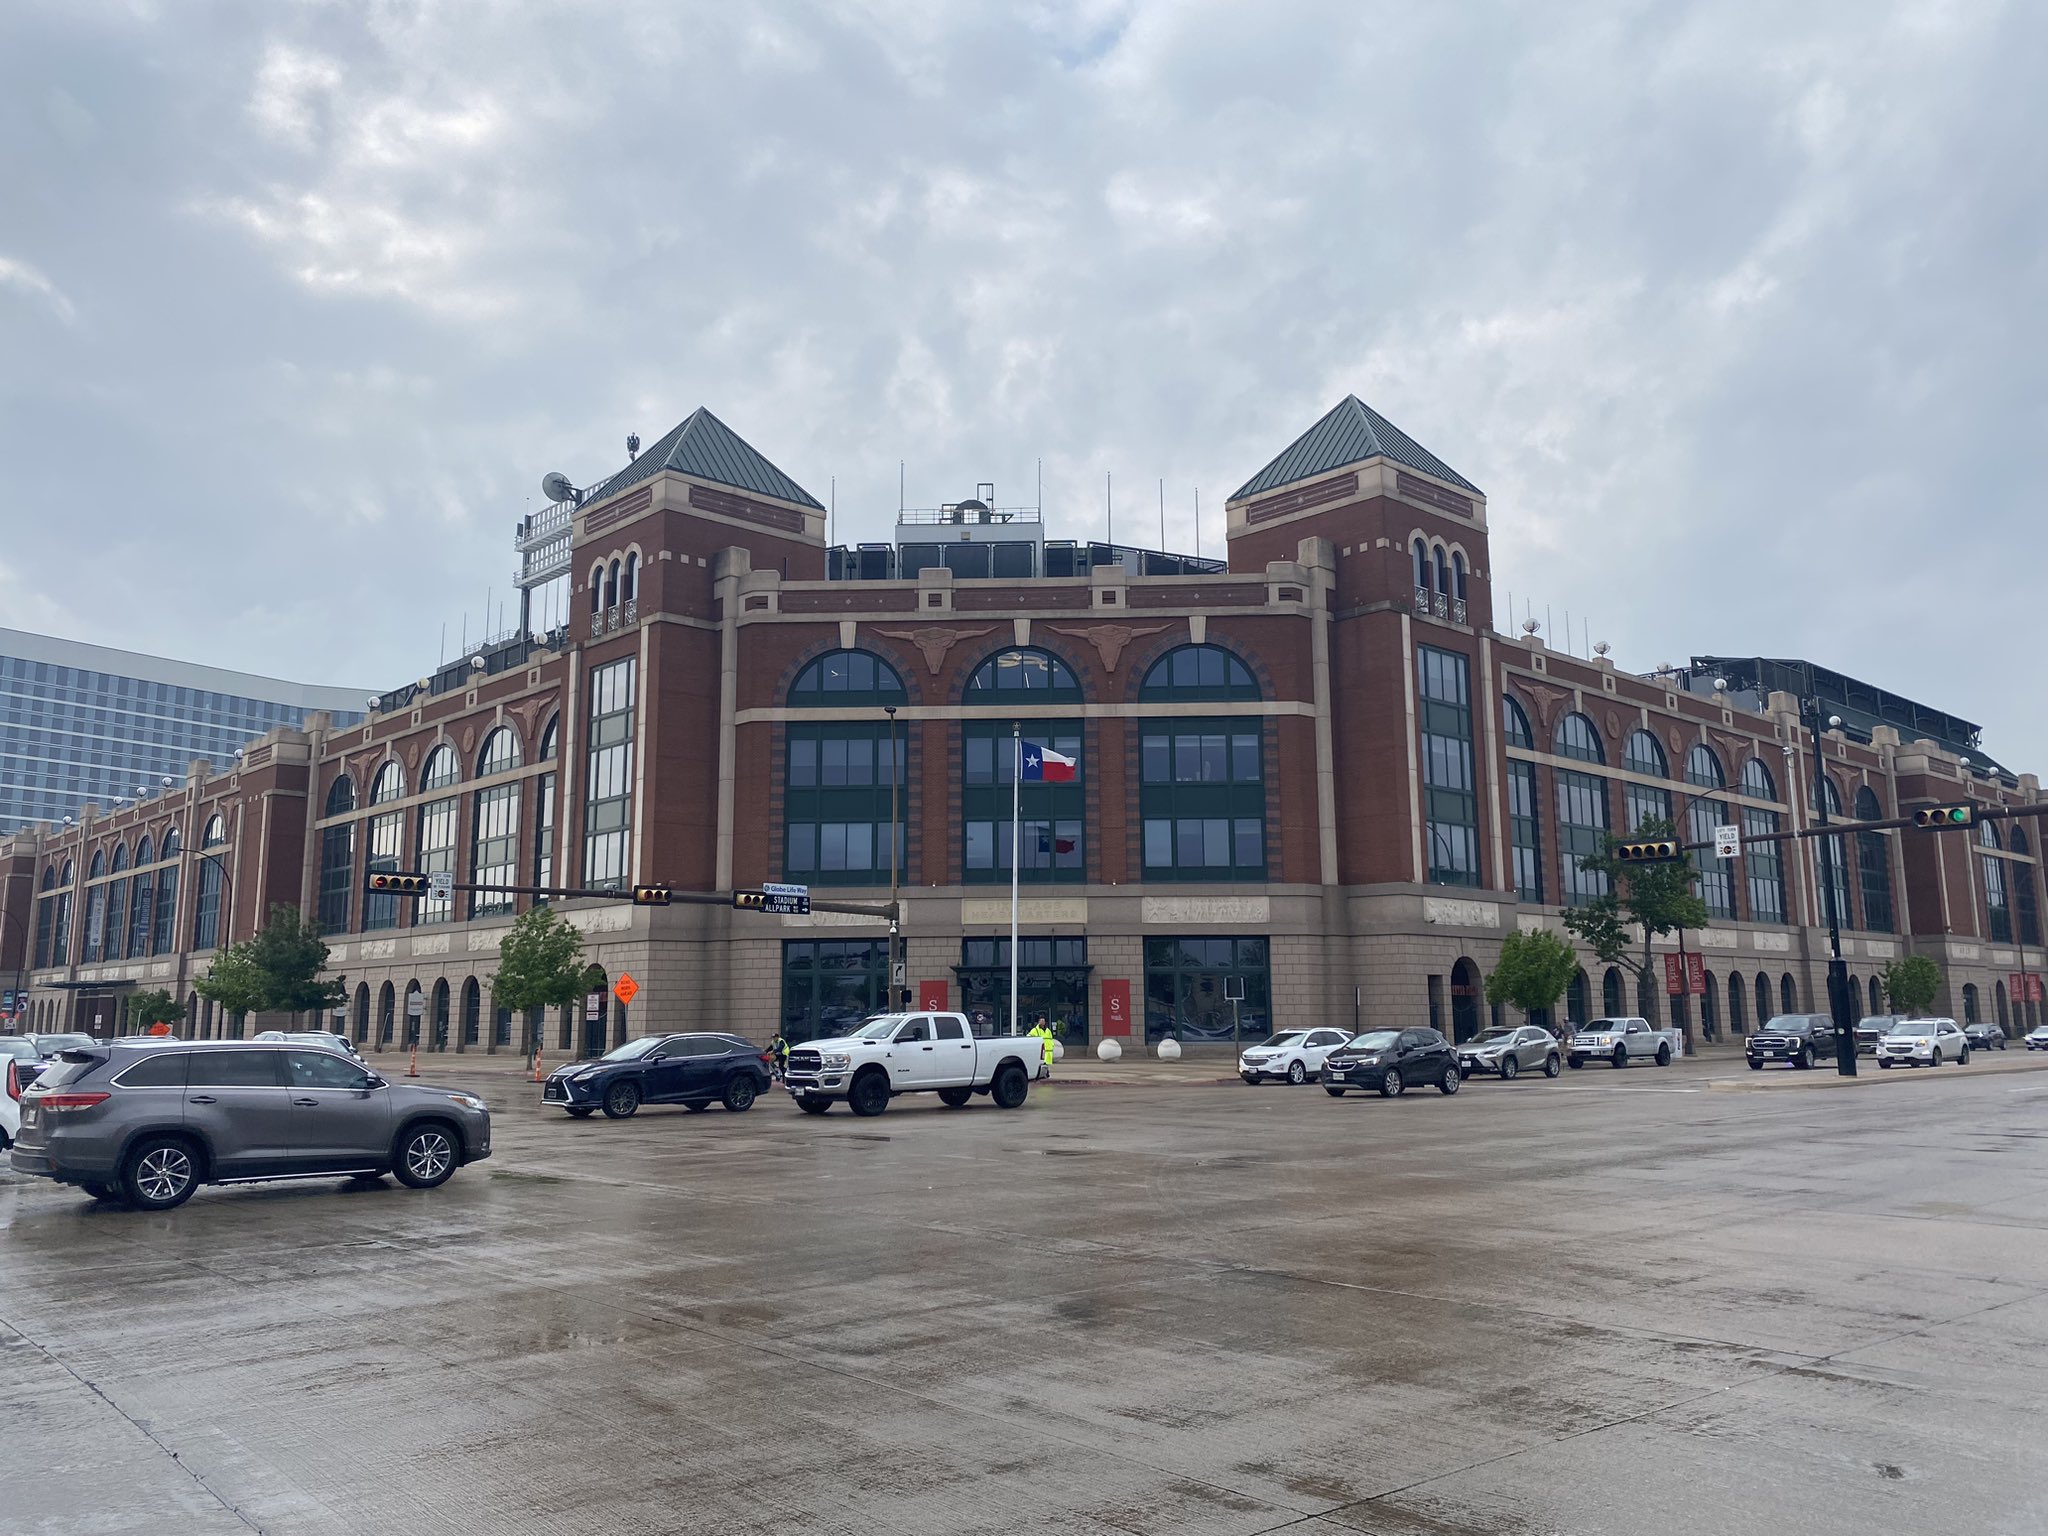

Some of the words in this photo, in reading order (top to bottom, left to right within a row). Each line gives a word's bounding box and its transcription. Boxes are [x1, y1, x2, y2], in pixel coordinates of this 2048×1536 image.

[1719, 832, 1736, 840] YIELD
[771, 885, 786, 893] Globe
[797, 887, 807, 895] Way
[773, 896, 798, 905] STADIUM
[764, 904, 791, 913] ALLPARK
[1667, 957, 1679, 981] spark
[1690, 956, 1703, 981] spark
[928, 999, 938, 1011] S
[1111, 998, 1120, 1010] S
